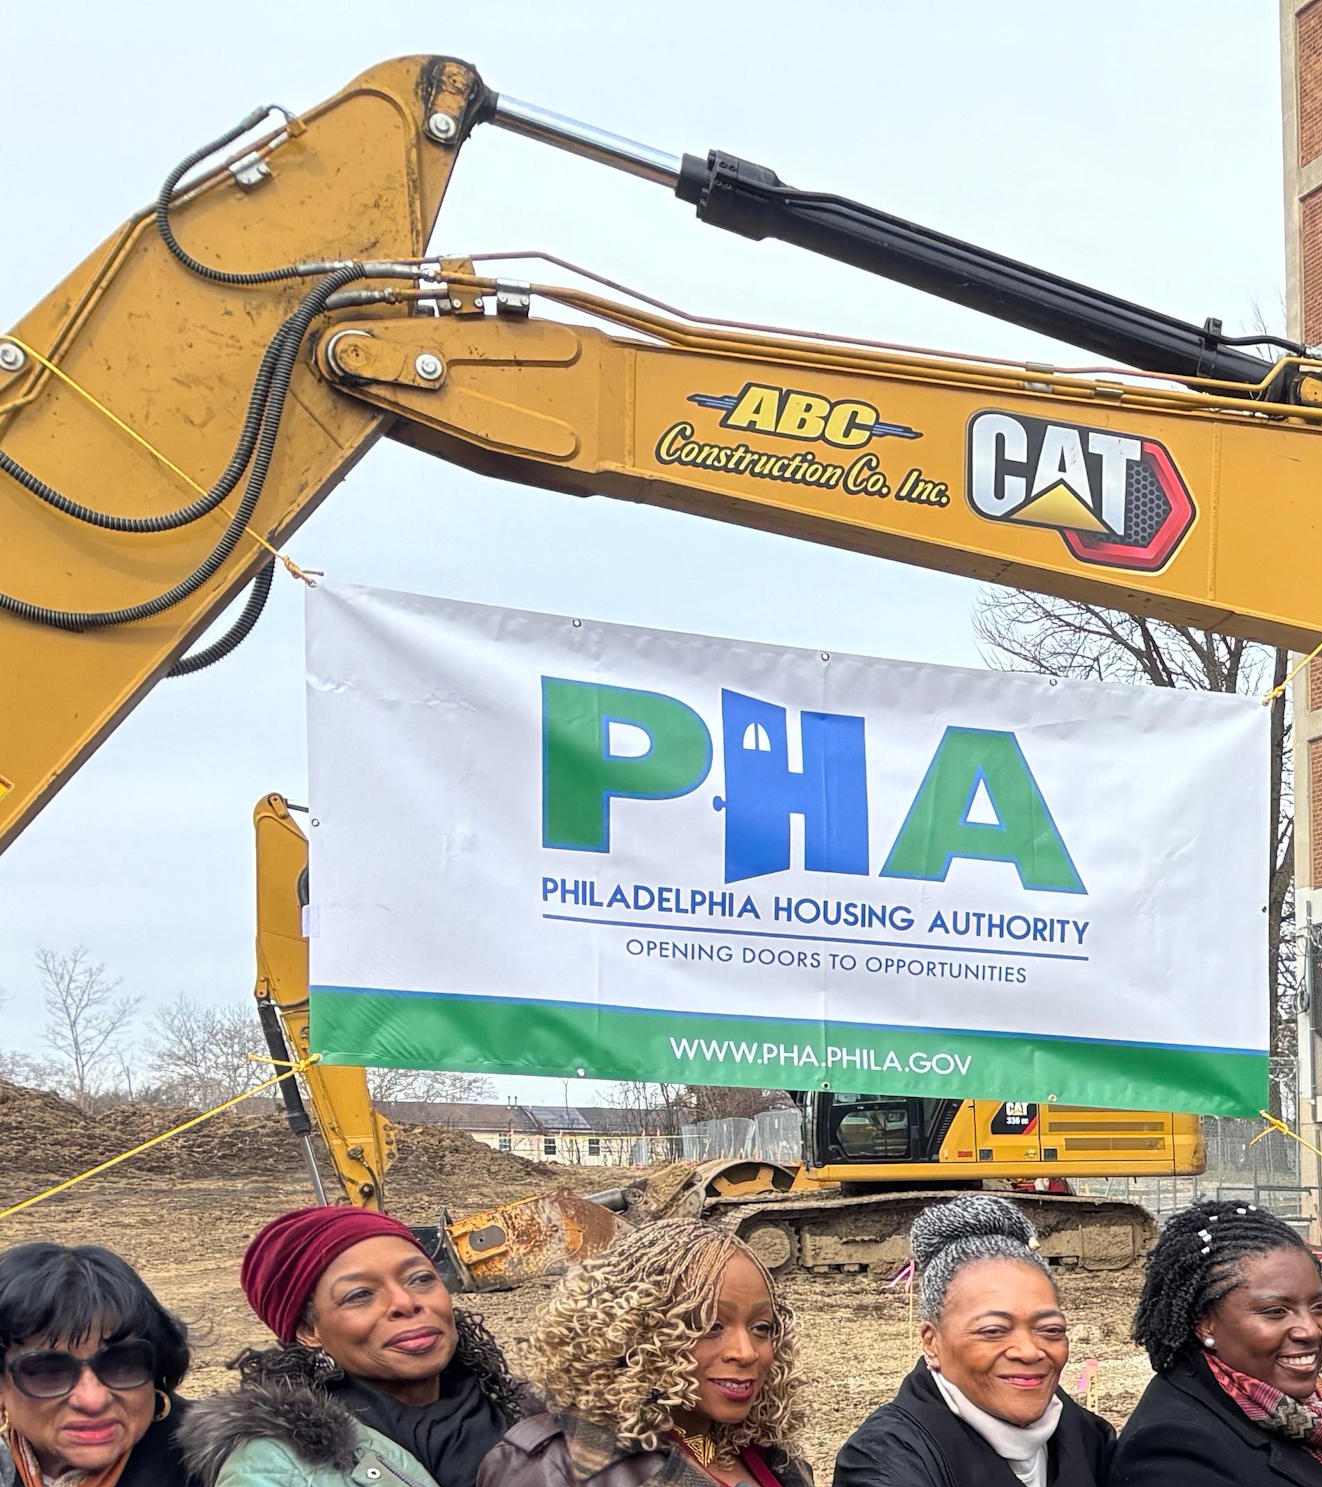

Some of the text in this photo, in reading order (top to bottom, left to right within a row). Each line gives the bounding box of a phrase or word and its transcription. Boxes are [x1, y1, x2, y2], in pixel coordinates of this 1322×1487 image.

[724, 385, 878, 446] ABC
[658, 424, 949, 504] Construction Co. Inc.
[972, 413, 1142, 536] CAT
[541, 675, 1088, 895] PHA
[541, 876, 1090, 945] PHILADELPHIA HOUSING AUTHORITY
[625, 938, 1027, 984] OPENING DOORS TO OPPORTUNITIES
[669, 1036, 973, 1076] WWW.PHA.PHILA.GOV
[1005, 1101, 1029, 1116] CAT
